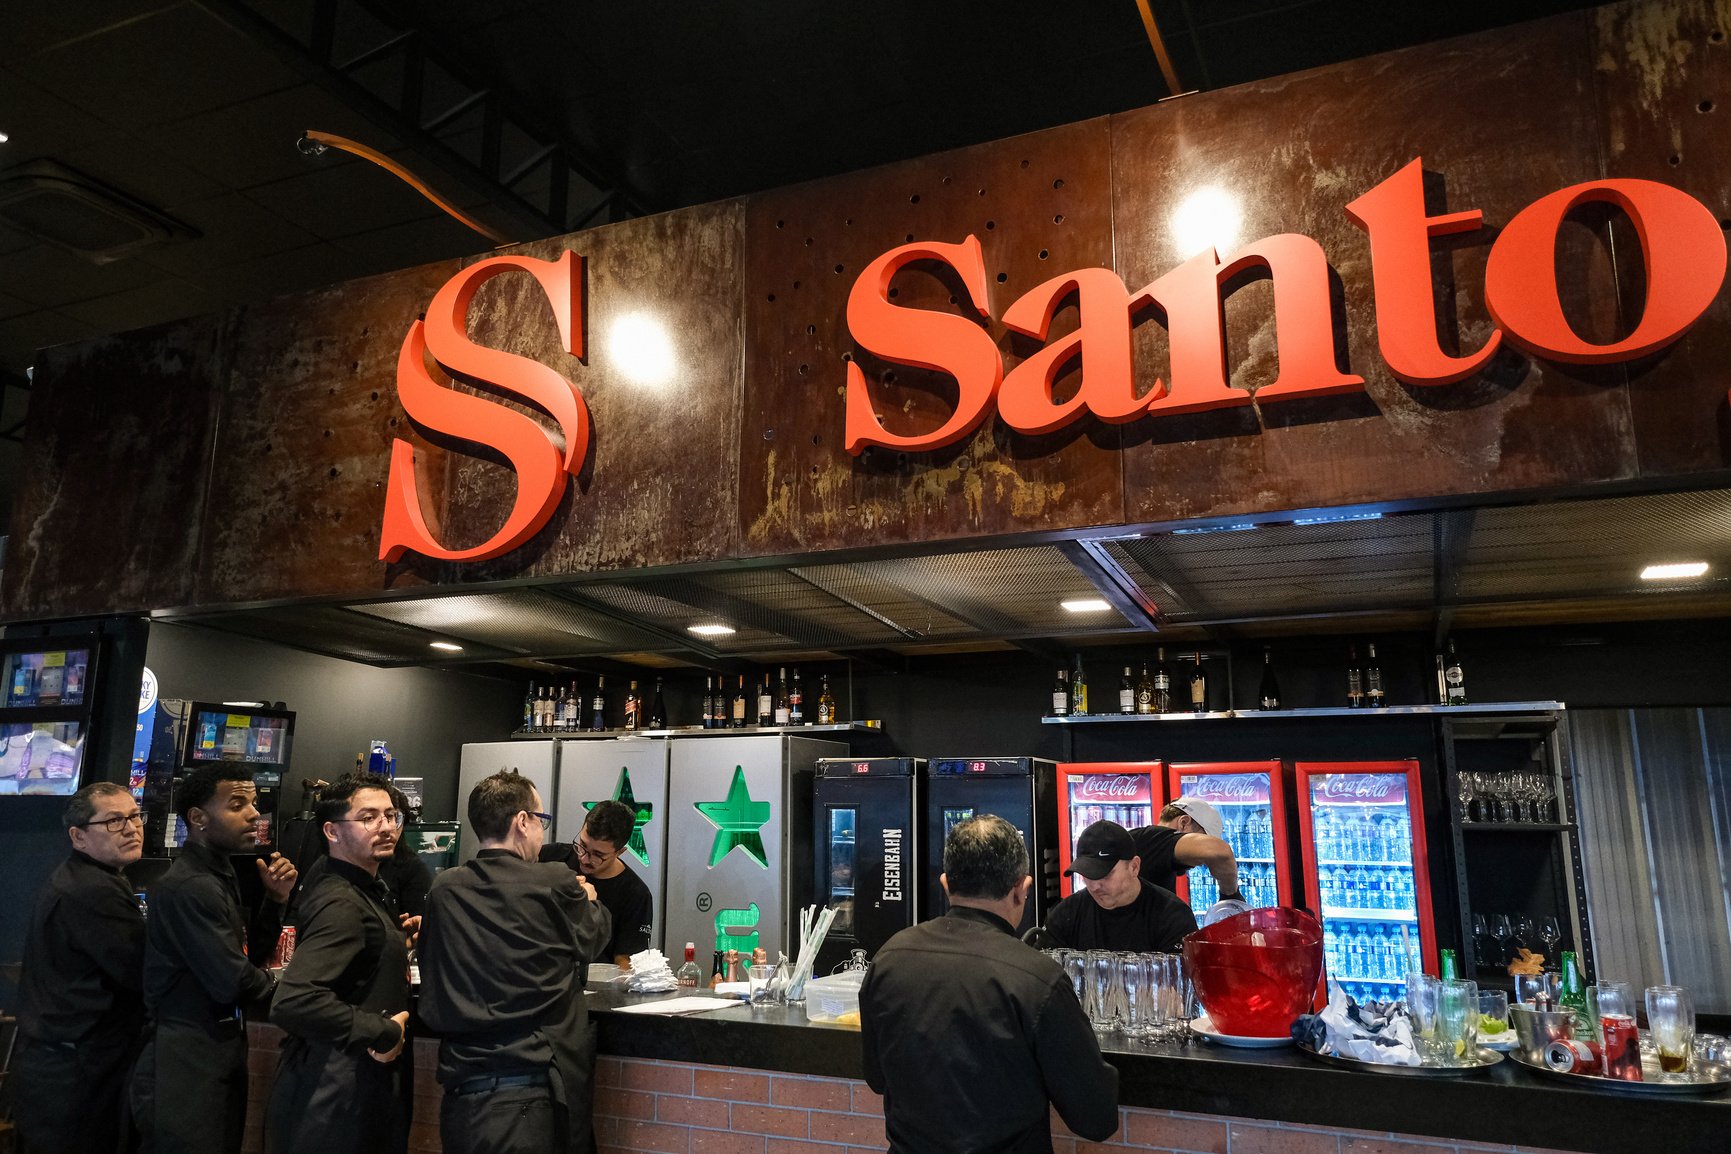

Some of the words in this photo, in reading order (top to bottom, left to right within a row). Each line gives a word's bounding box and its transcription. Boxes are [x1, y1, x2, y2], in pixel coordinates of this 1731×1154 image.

[846, 156, 1727, 455] Santo
[379, 249, 590, 563] S
[1083, 775, 1139, 796] Coca-Cola
[1197, 776, 1257, 797] Coca-Cola
[1325, 775, 1391, 797] Coca-Cola
[882, 828, 902, 901] EISENBAHN
